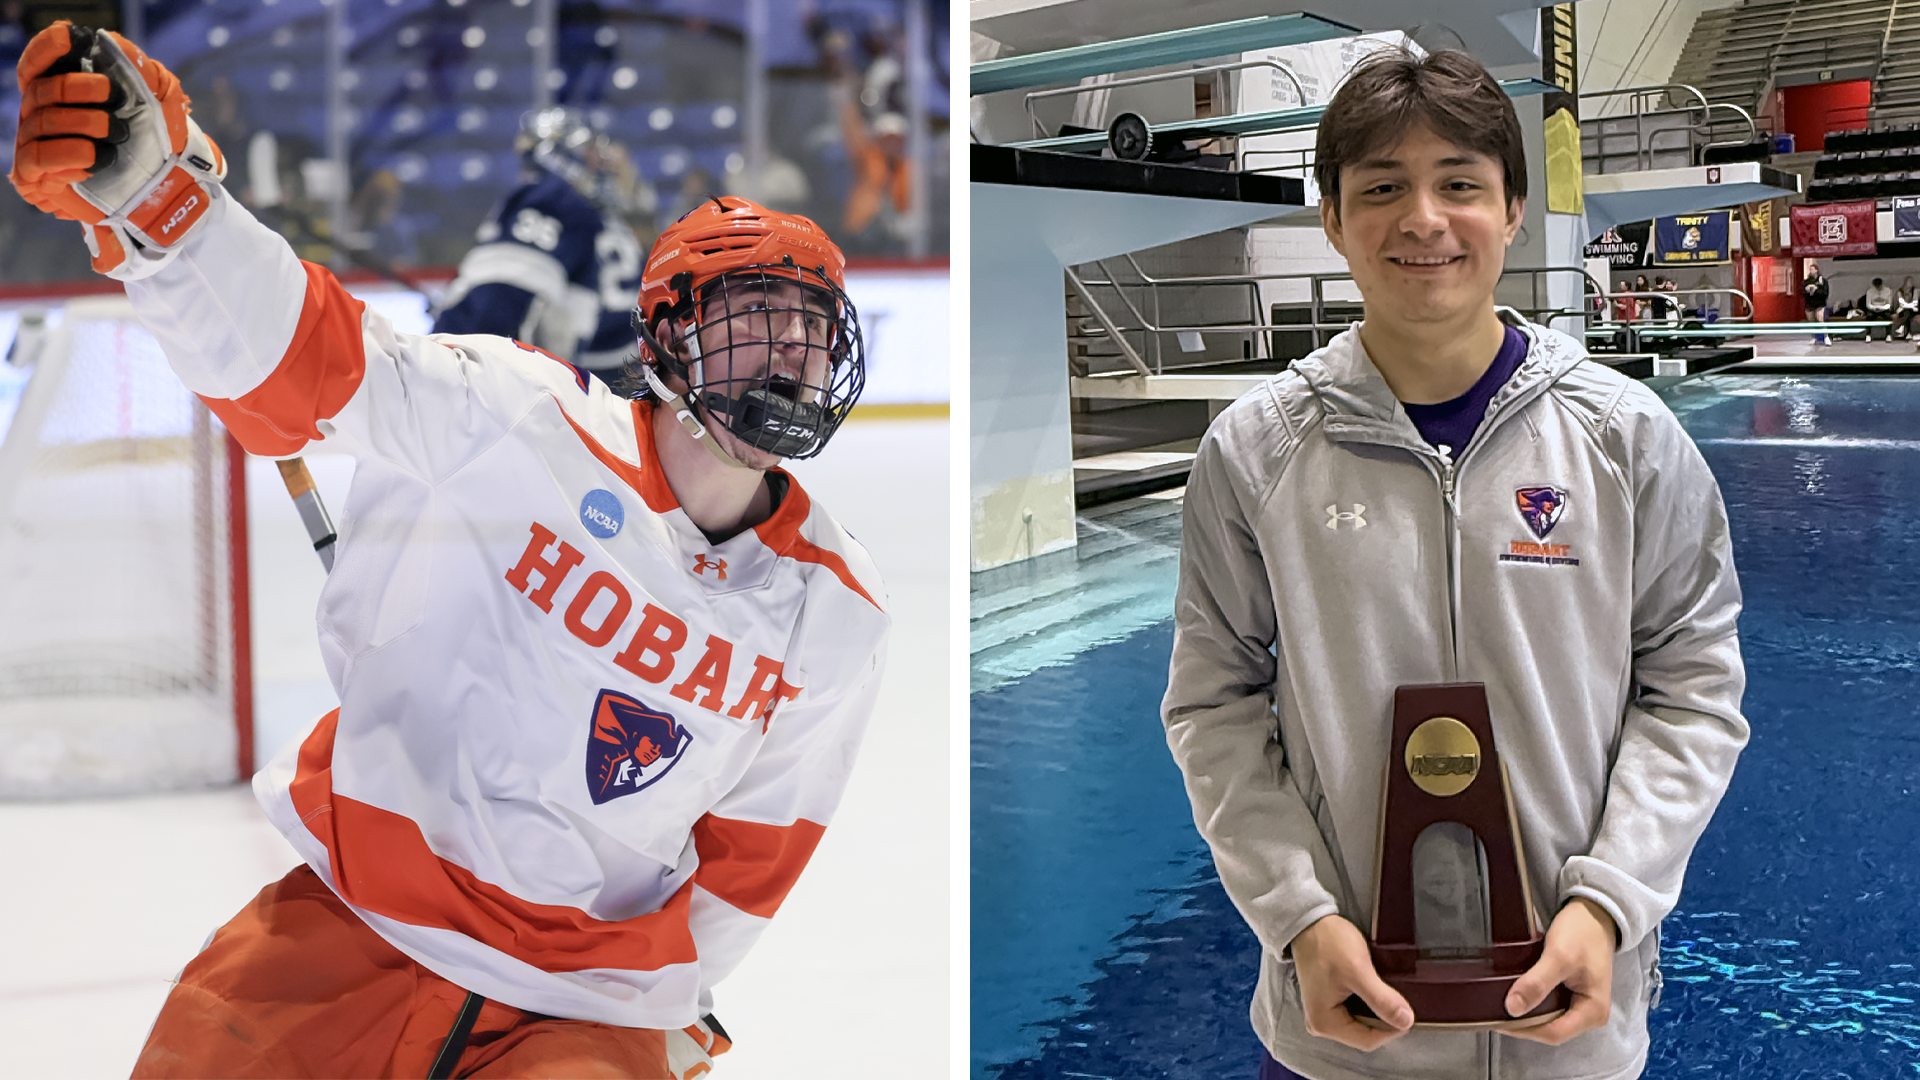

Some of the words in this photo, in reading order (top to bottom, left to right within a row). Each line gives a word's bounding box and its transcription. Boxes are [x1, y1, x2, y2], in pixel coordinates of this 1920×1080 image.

[162, 195, 198, 234] CCM
[781, 220, 811, 234] HOBART
[1585, 242, 1639, 255] SWIMMING
[584, 505, 619, 534] NCAA
[1411, 754, 1477, 776] NCAA
